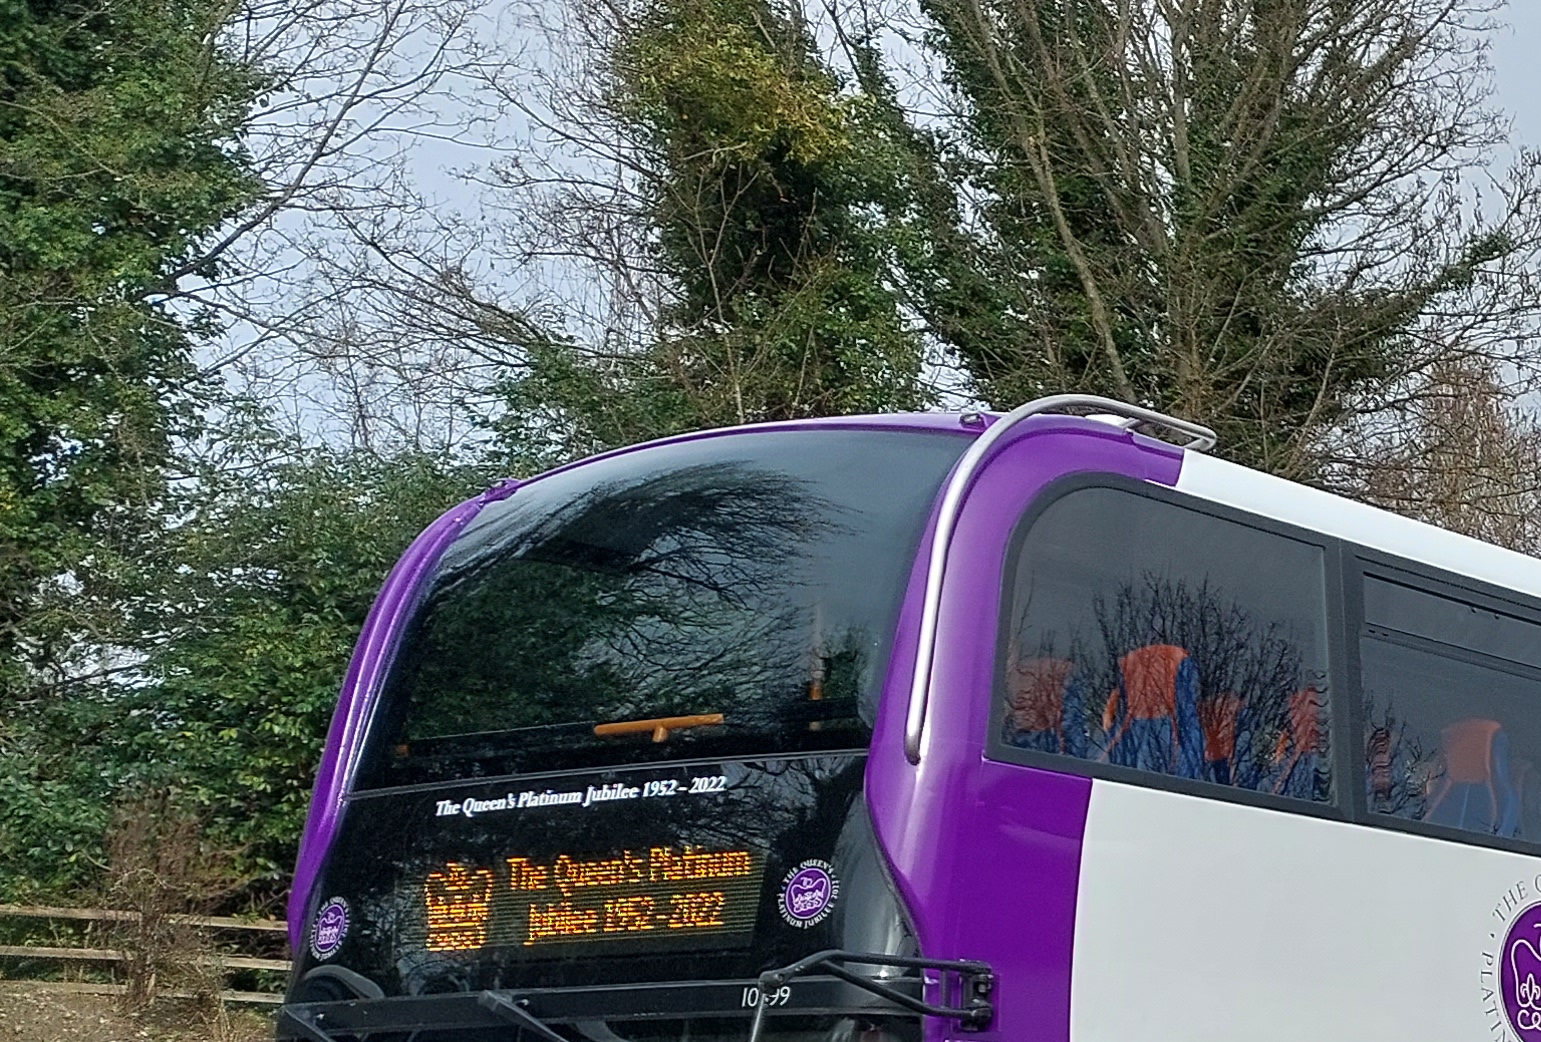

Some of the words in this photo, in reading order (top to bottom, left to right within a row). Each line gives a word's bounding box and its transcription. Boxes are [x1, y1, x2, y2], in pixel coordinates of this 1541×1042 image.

[435, 800, 461, 816] The
[463, 790, 515, 817] Queen's
[517, 789, 582, 808] Platinum
[583, 783, 639, 807] Jubilee
[643, 780, 678, 797] 1952
[689, 776, 728, 794] 2022
[506, 857, 547, 890] The
[554, 850, 643, 896] Queen's
[649, 846, 750, 882] Platinum
[1492, 881, 1528, 922] THE
[523, 903, 597, 946] Jubilee
